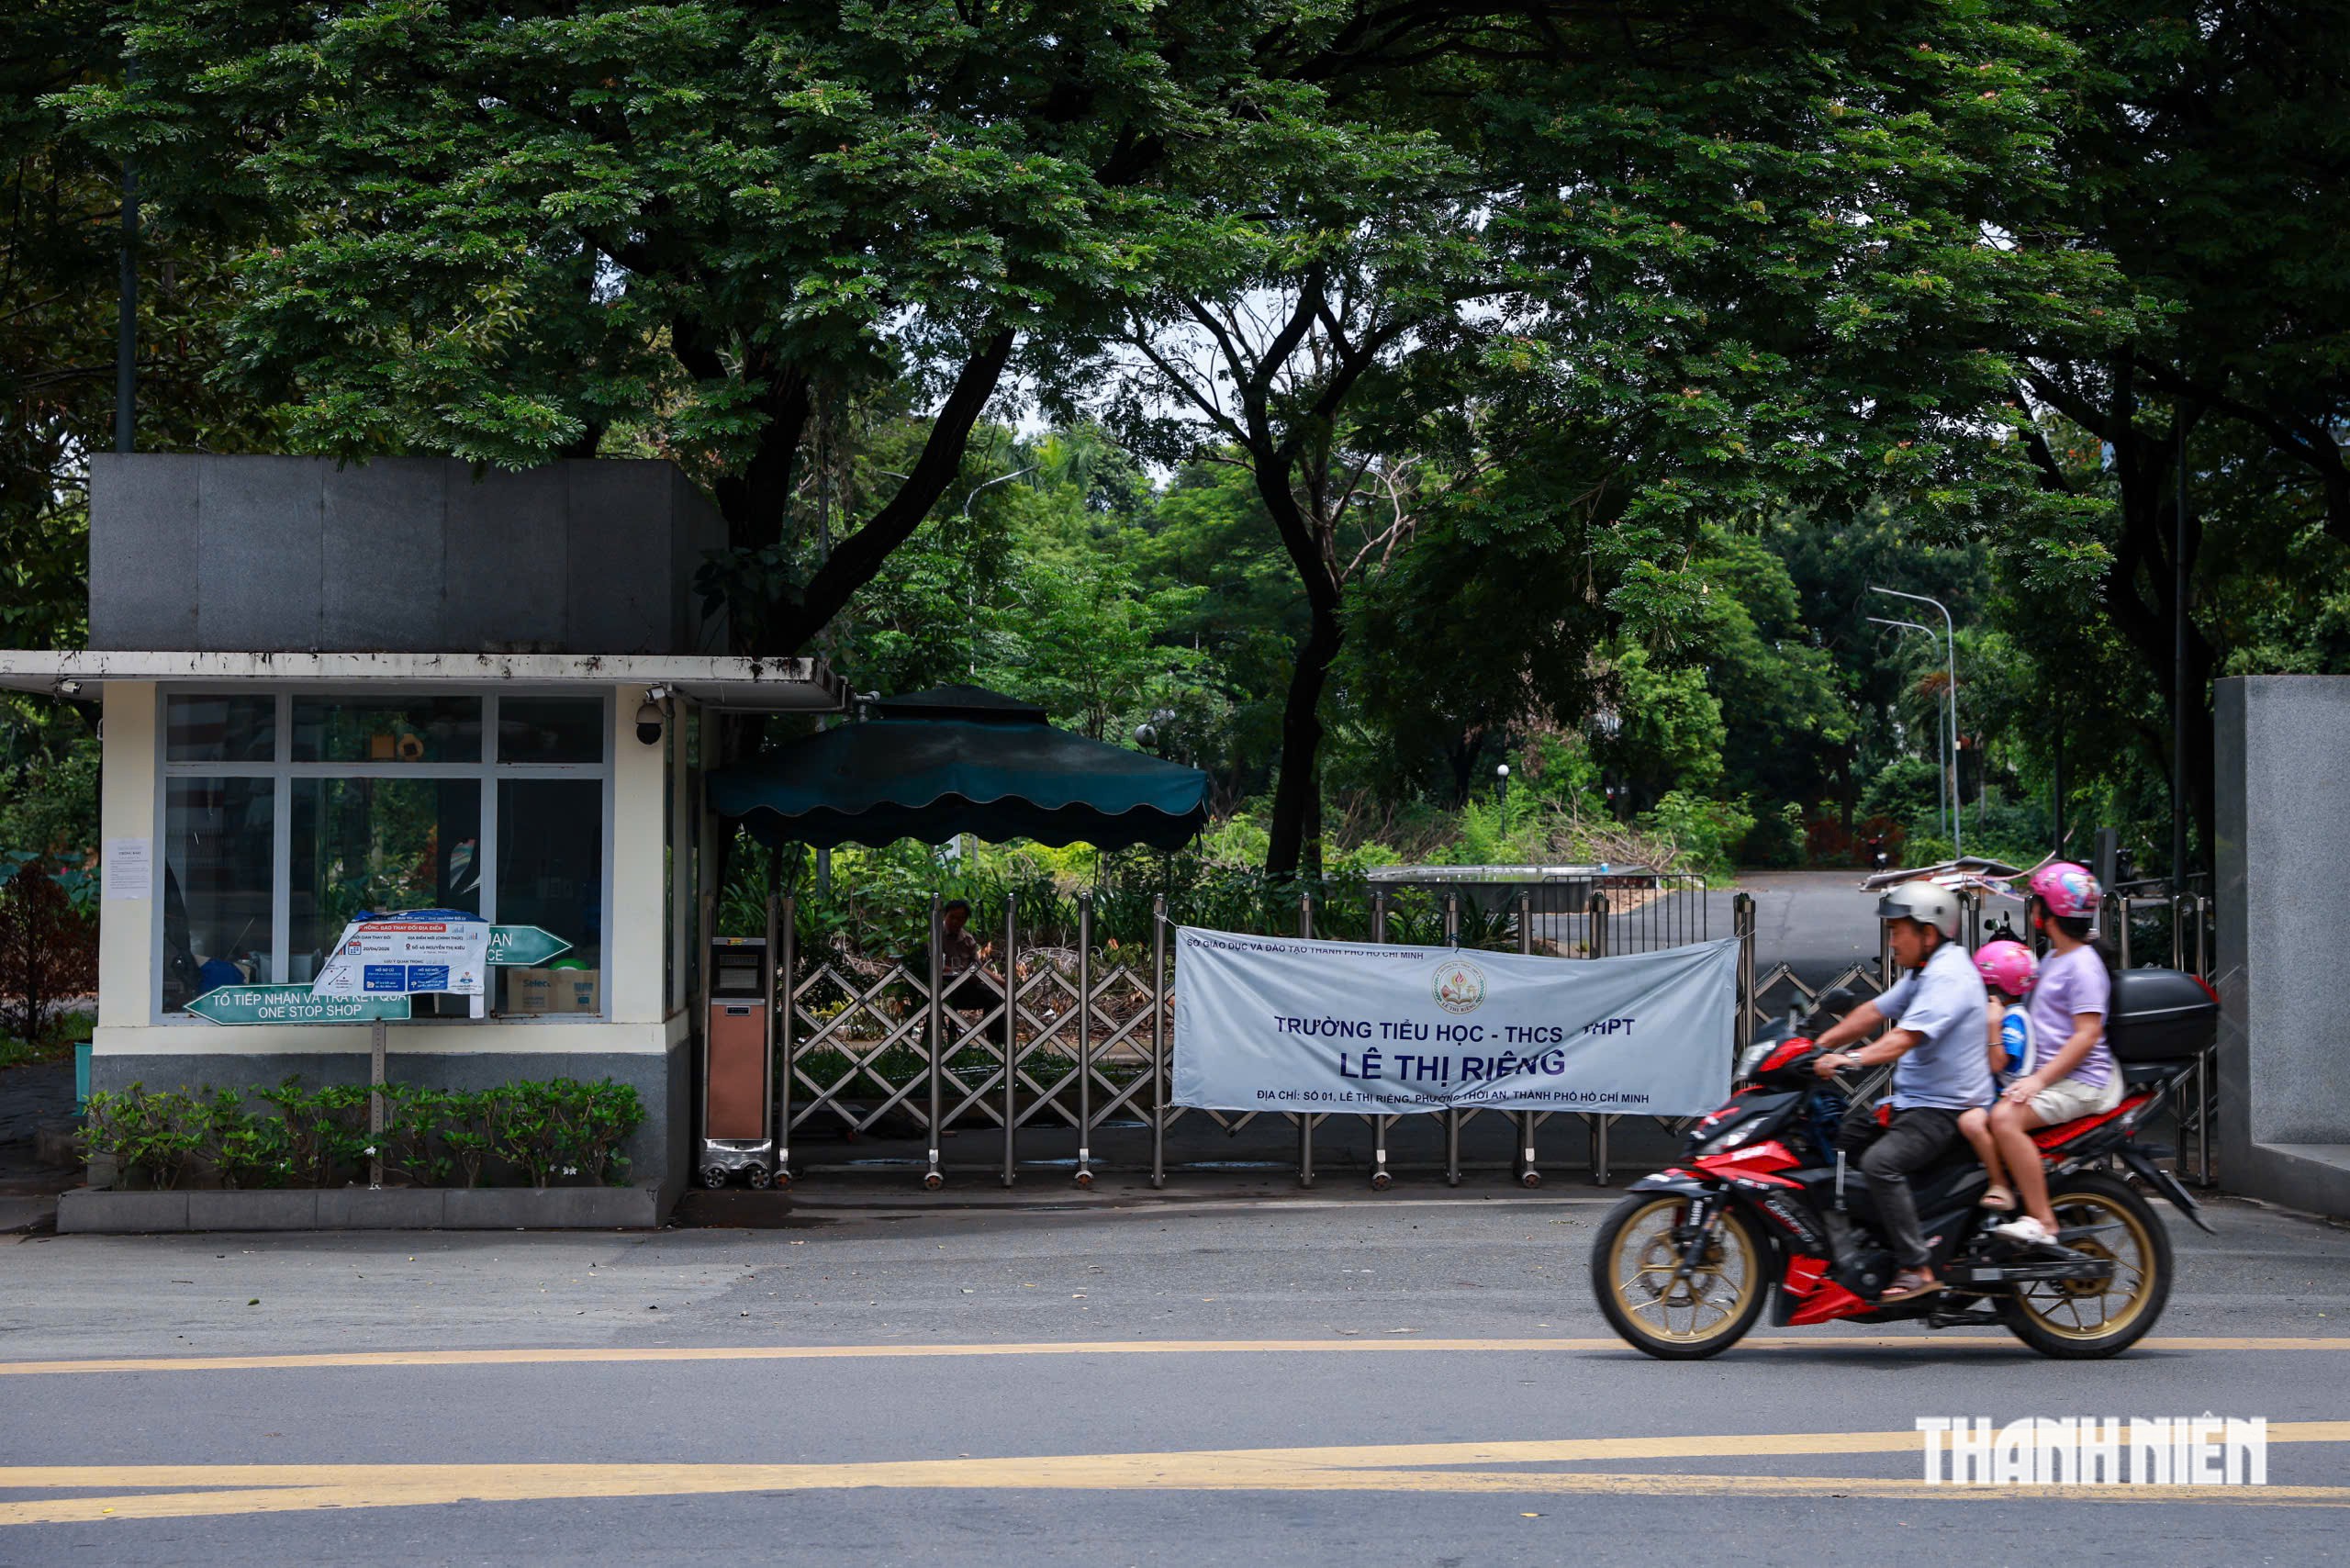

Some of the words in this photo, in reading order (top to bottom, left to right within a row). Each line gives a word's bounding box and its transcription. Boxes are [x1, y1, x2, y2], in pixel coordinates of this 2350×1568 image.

[487, 949, 504, 961] CE
[1187, 938, 1201, 946] SỞ
[1203, 940, 1226, 948] GIÁO
[1228, 942, 1248, 951] DỤC
[1289, 946, 1307, 955] TẠO
[1400, 951, 1424, 960] MINH
[213, 991, 230, 1006] TỔ
[233, 991, 262, 1006] TIẾP
[264, 991, 300, 1006] NHẬN
[258, 1006, 285, 1018] ONE
[289, 1005, 323, 1017] STOP
[326, 1004, 362, 1016] SHOP
[1274, 1015, 1372, 1039] TRƯỜNG
[1379, 1018, 1428, 1041] TIỂU
[1436, 1024, 1483, 1046] HỌC
[1505, 1026, 1563, 1044] THCS
[1583, 1018, 1635, 1036] THPT
[1339, 1047, 1382, 1080] LÊ
[1393, 1055, 1449, 1088] THỊ
[1460, 1049, 1565, 1081] RIÊNG
[1257, 1090, 1276, 1101] ĐỊA
[1303, 1090, 1319, 1101] SỐ
[1322, 1092, 1337, 1102] 01,
[1339, 1091, 1353, 1102] LÊ
[1356, 1092, 1373, 1103] THỊ
[1513, 1089, 1550, 1101] THÀNH
[1553, 1091, 1578, 1102] PHỐ
[1580, 1091, 1597, 1102] HỒ
[1599, 1092, 1619, 1103] CHÍ
[1621, 1093, 1650, 1103] MINH
